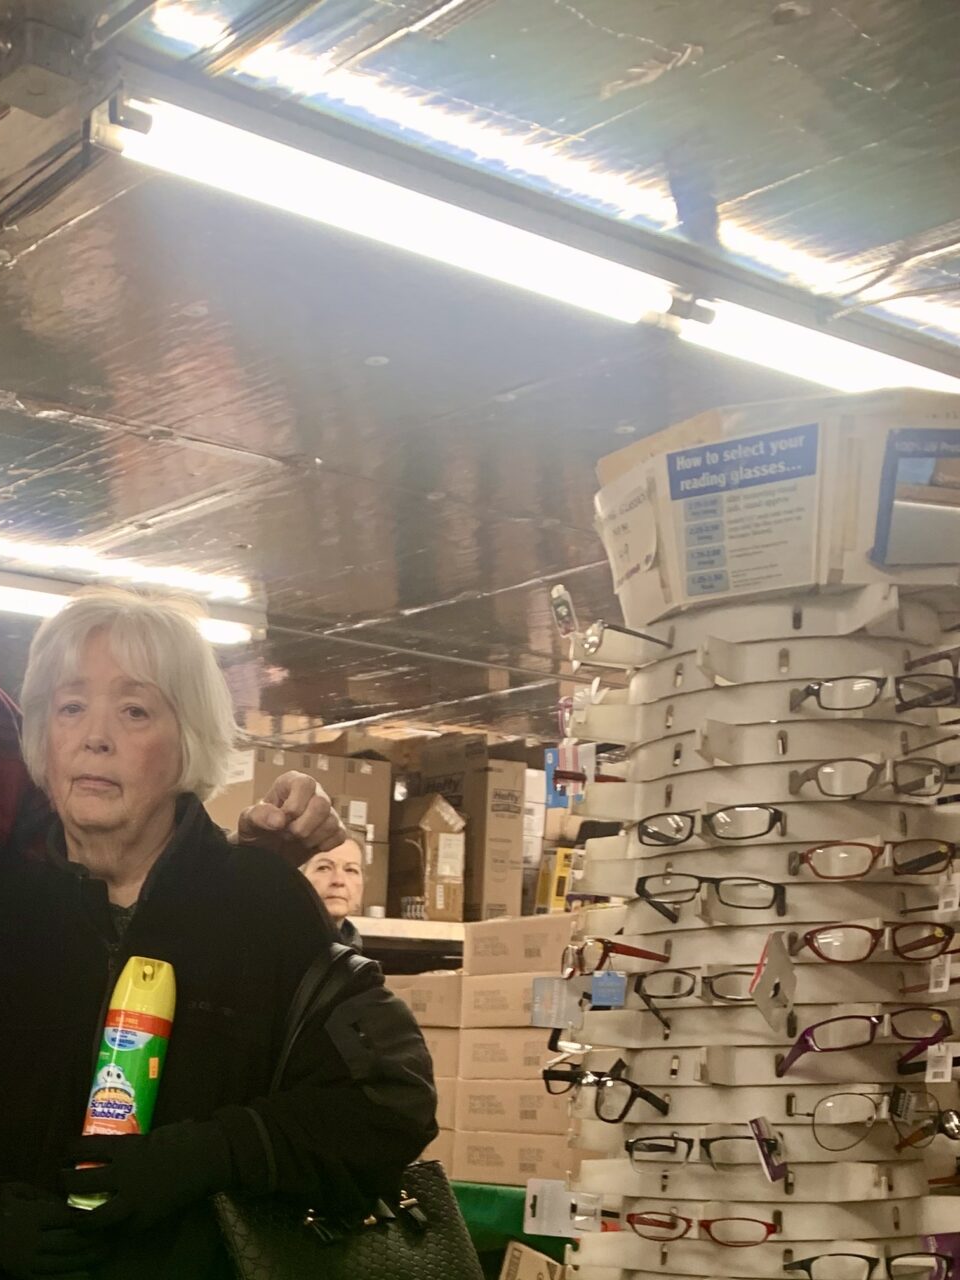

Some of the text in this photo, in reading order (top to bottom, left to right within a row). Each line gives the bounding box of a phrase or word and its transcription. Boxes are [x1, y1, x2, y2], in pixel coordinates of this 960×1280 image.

[675, 434, 805, 471] How to select your
[679, 460, 802, 492] reading glasses...
